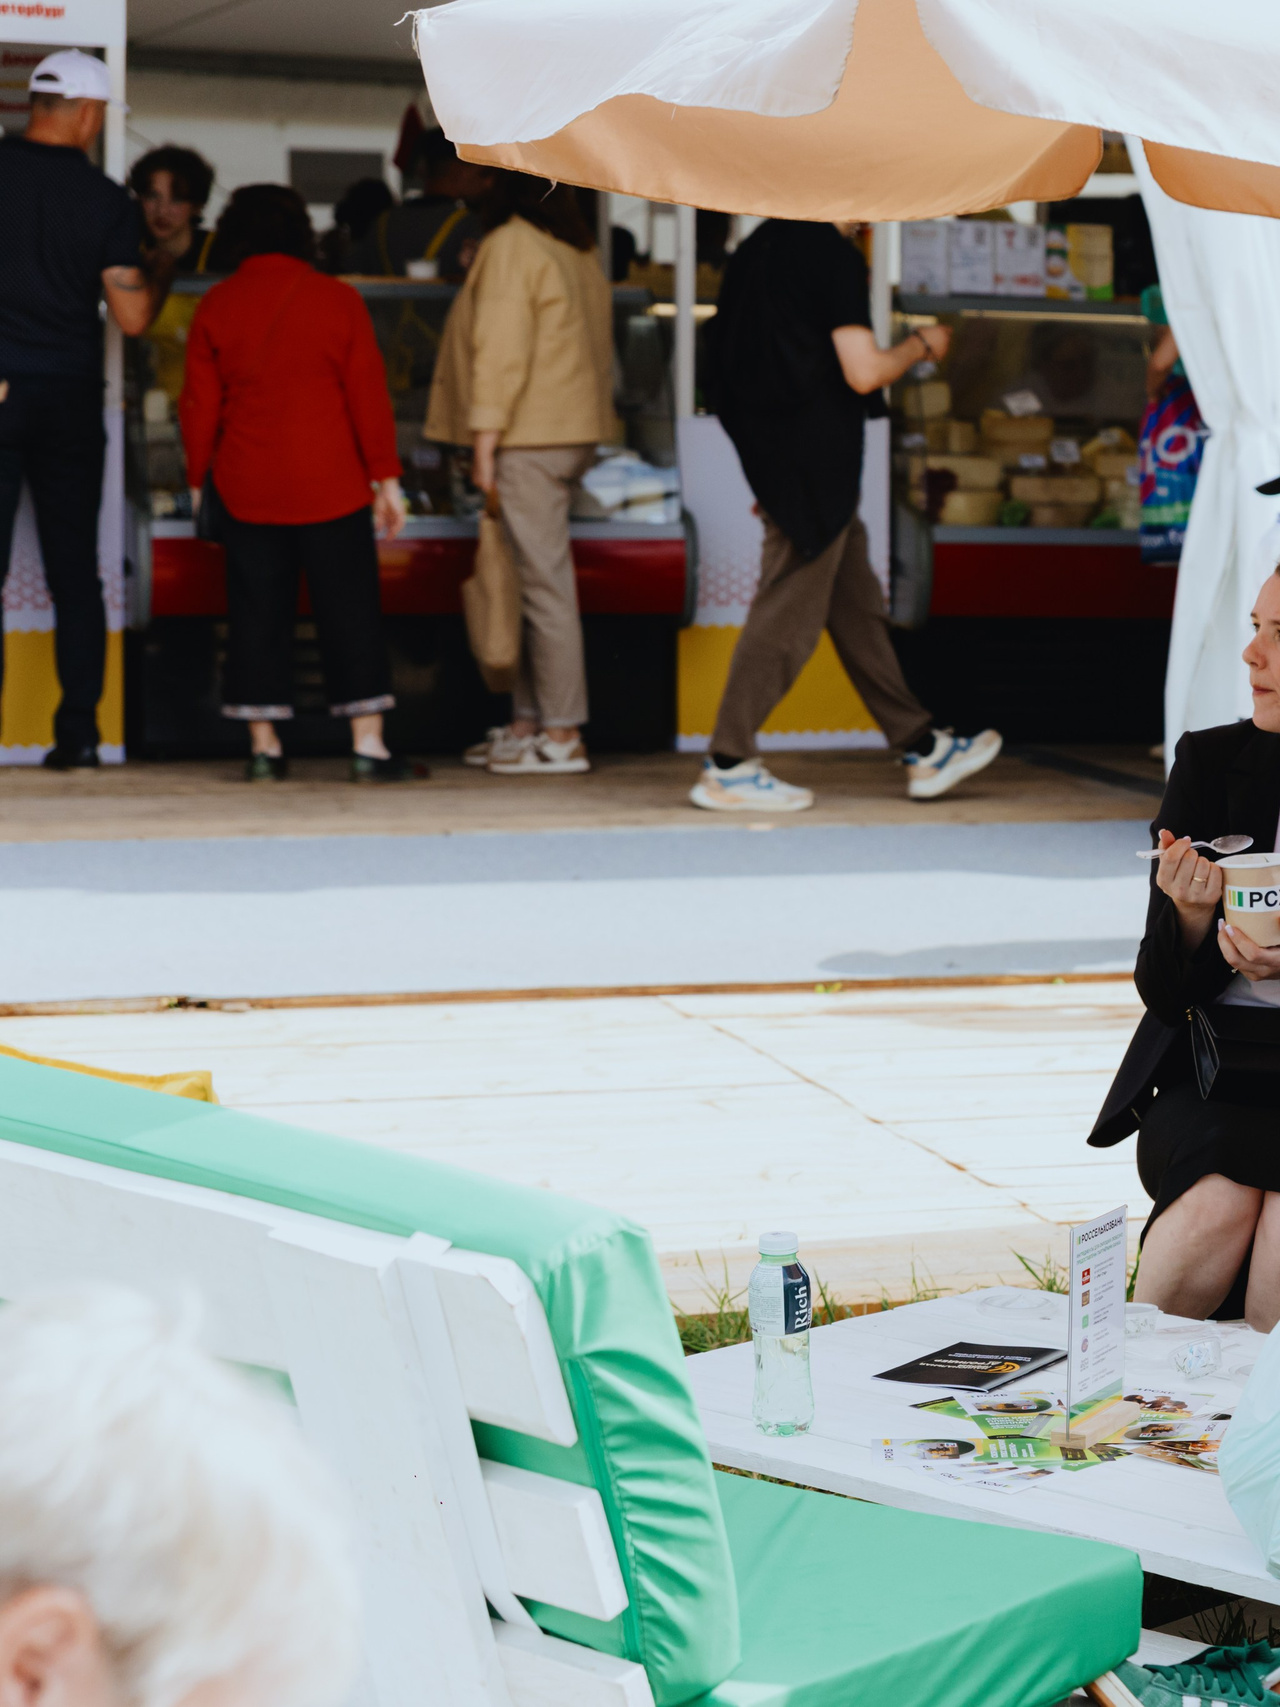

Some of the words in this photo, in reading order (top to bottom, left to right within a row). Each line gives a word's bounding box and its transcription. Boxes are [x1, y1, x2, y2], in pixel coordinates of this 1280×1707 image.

[0, 4, 65, 17] етербург
[1081, 1216, 1124, 1244] РОССЕЛЬХОЗБАНК
[794, 1285, 808, 1330] Rich
